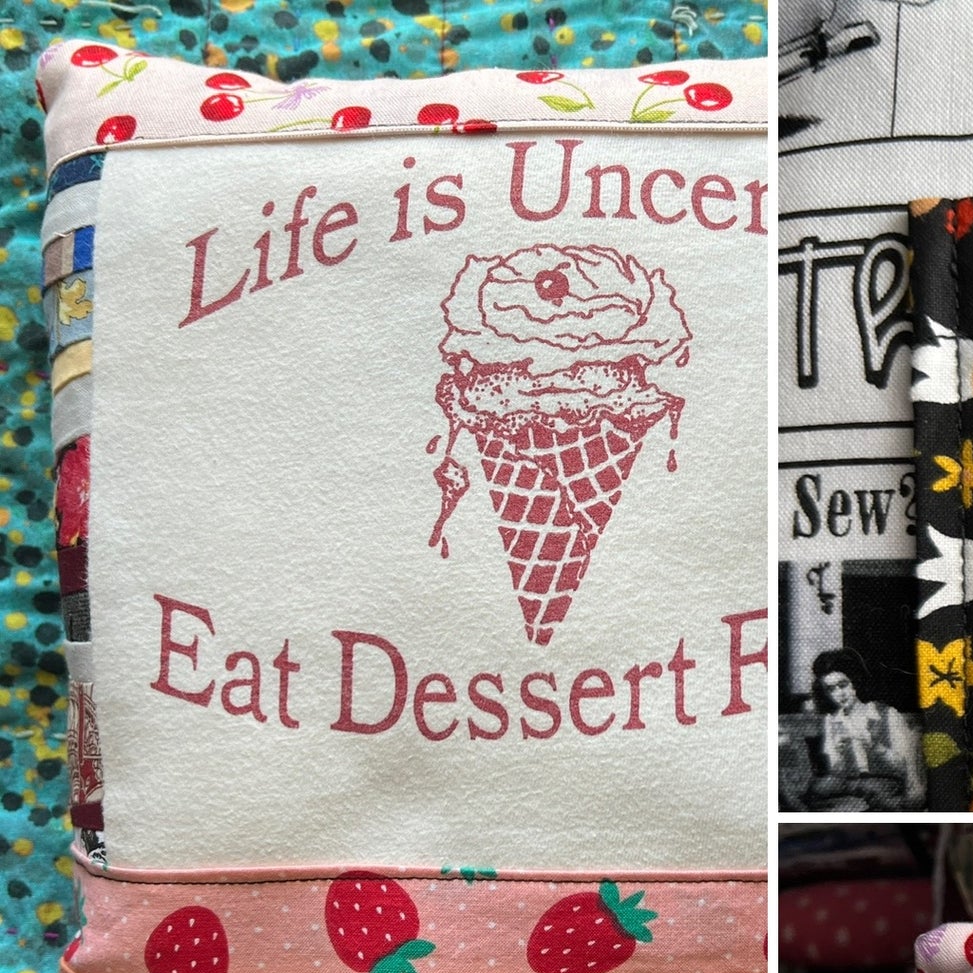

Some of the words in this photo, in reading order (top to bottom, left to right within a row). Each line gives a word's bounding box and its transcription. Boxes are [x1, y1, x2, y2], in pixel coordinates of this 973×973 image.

[178, 186, 359, 328] Life
[389, 158, 468, 244] is
[150, 593, 300, 730] Eat
[330, 629, 697, 742] Dessert
